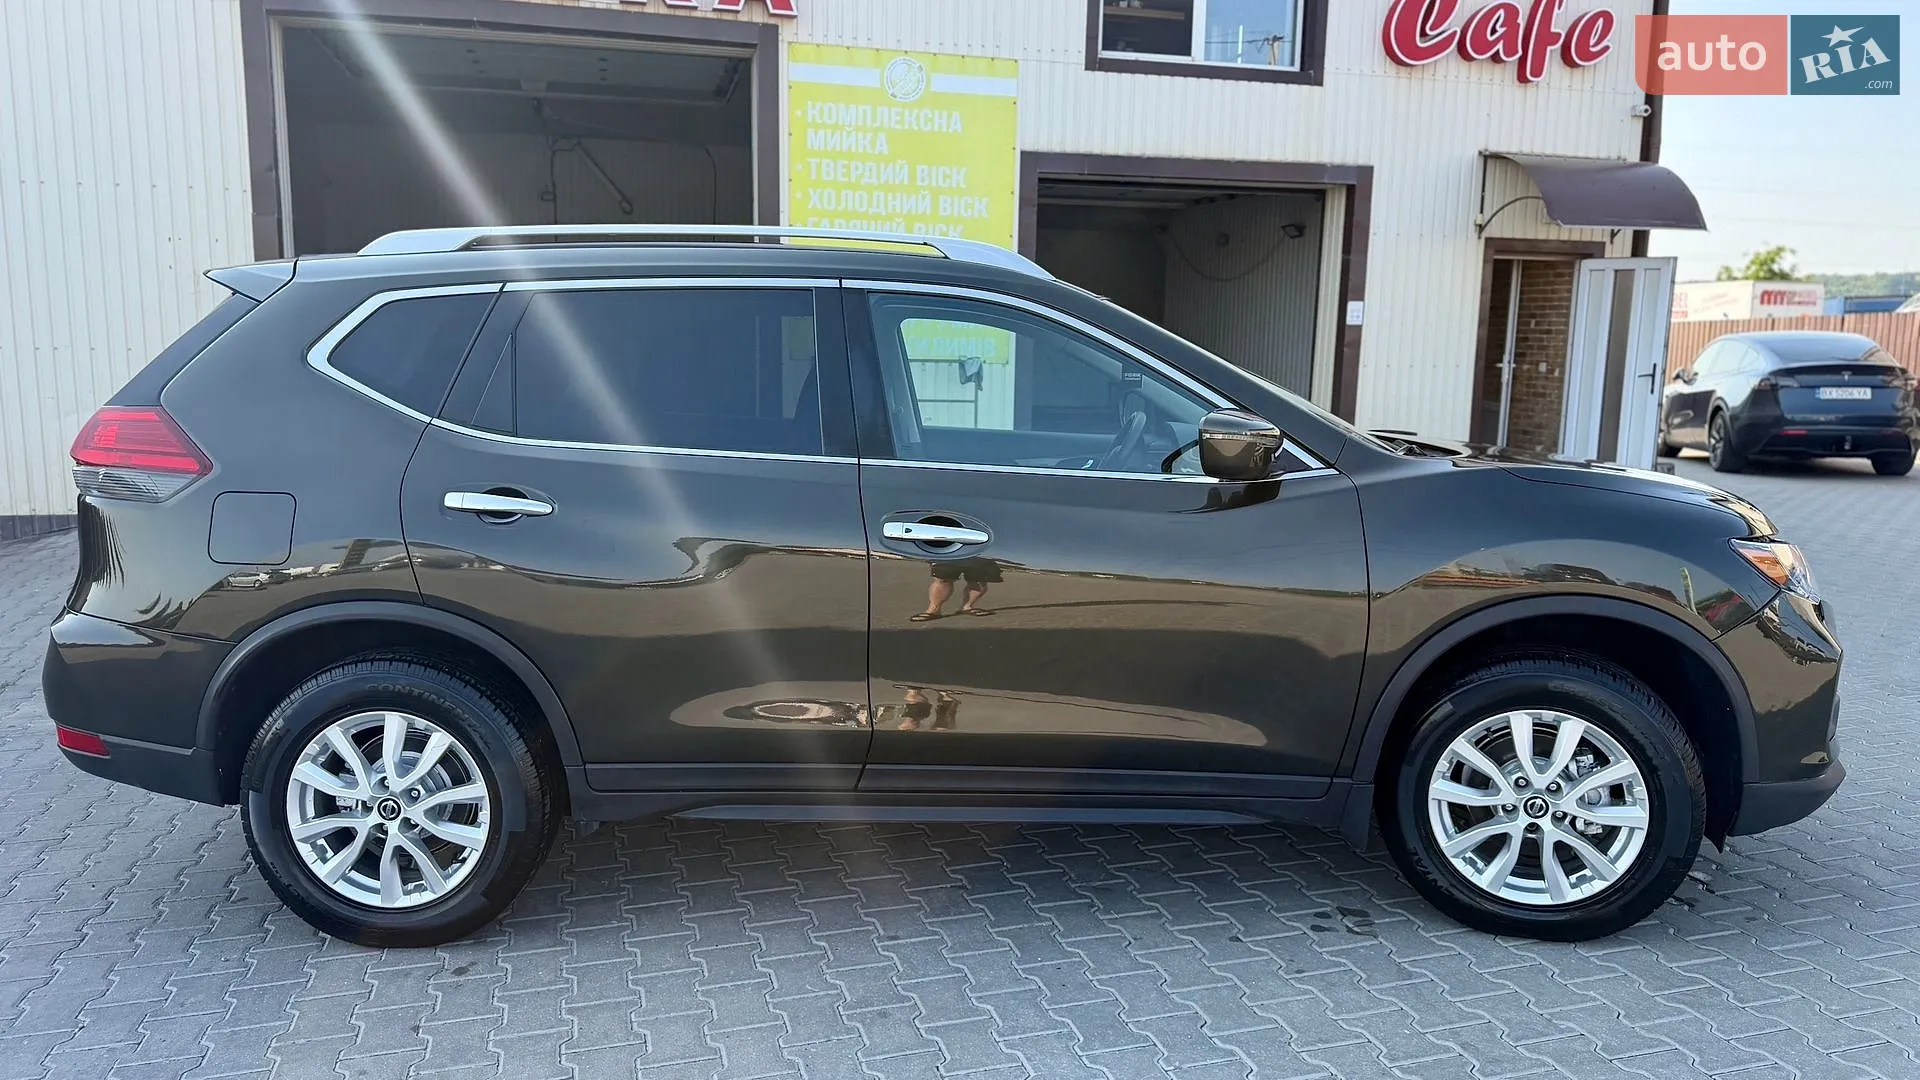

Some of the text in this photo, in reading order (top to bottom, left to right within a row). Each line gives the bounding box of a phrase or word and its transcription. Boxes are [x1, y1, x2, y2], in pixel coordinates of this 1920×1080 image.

[1382, 0, 1615, 83] Cafe
[806, 101, 963, 133] КОМПЛЕКСНА
[806, 126, 889, 154] МИЙКА
[807, 158, 967, 189] ТВЕРДИЙ ВІСК
[807, 188, 989, 218] ХОЛОДНИЙ ВІСК
